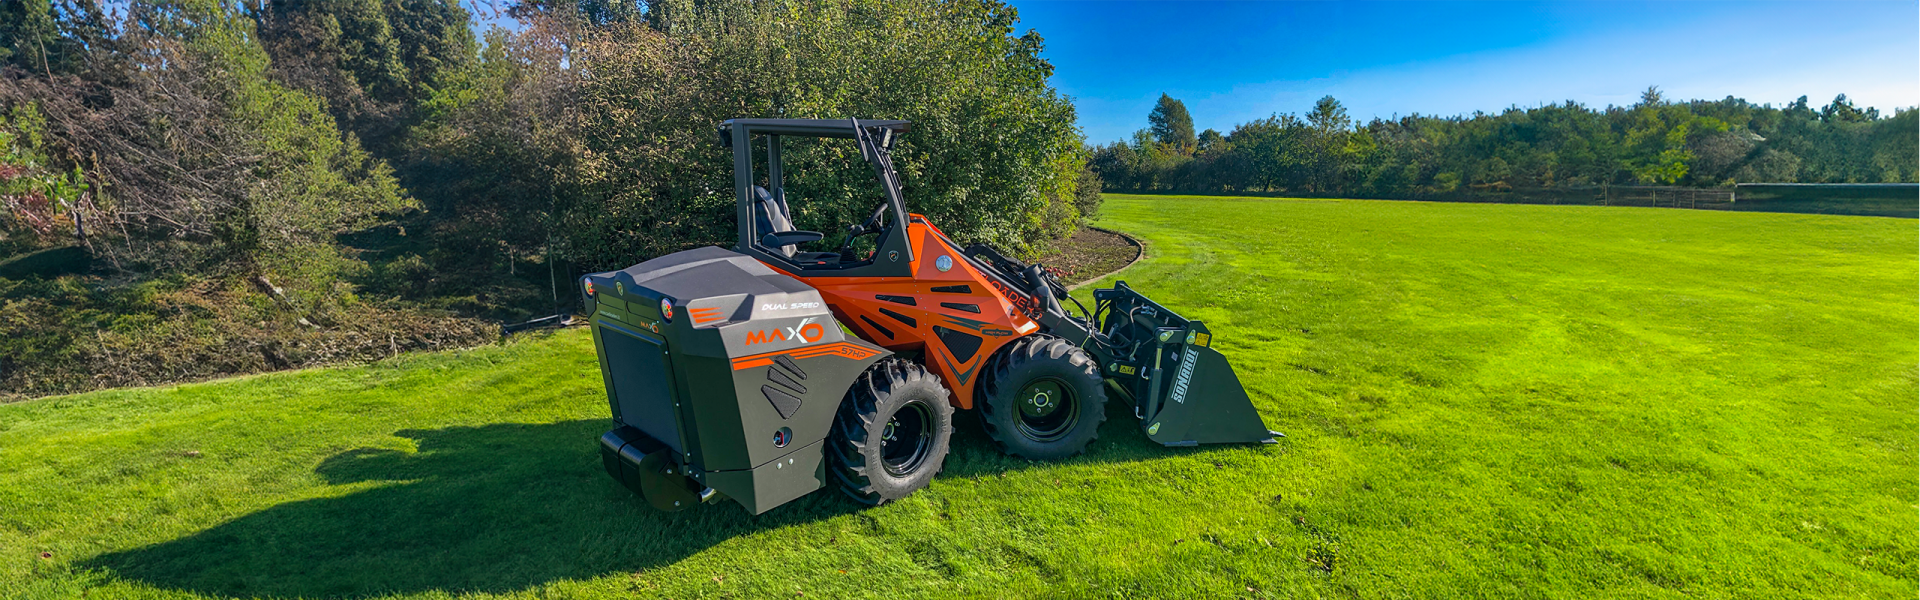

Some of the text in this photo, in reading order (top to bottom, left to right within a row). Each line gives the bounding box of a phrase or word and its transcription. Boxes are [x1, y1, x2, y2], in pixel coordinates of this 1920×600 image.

[761, 301, 820, 311] DUAL SPEED
[745, 317, 824, 346] MAXO
[841, 347, 866, 358] 57HP
[1173, 347, 1198, 403] SONAROL
